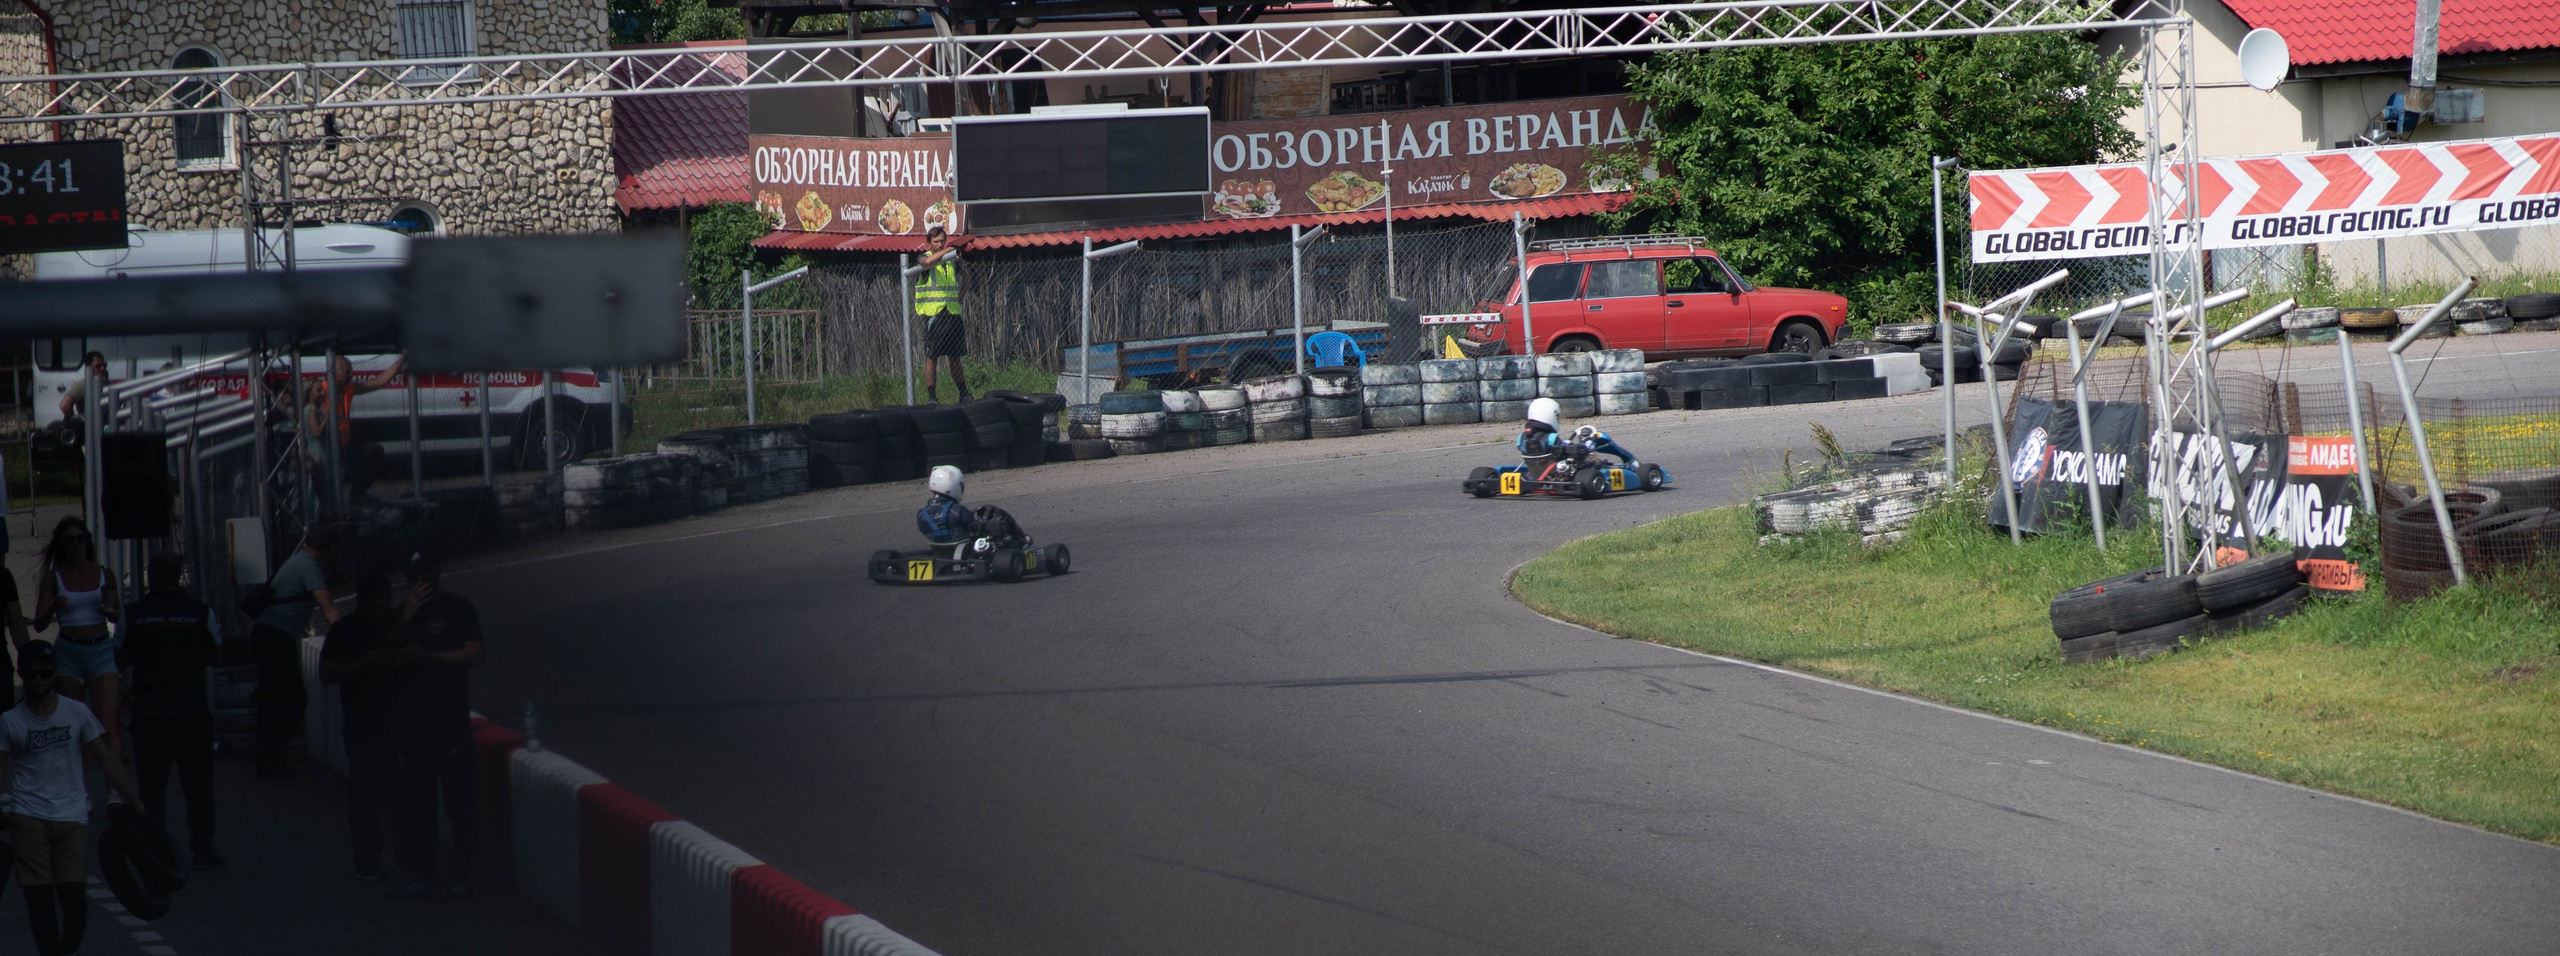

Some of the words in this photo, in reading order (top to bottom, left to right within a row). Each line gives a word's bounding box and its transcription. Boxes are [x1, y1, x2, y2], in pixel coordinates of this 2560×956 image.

[1213, 120, 1453, 173] ОБЗОРНАЯ
[1465, 104, 1665, 155] ВЕРАНДА
[755, 146, 861, 188] ОБЗОРНАЯ
[2052, 450, 2126, 486] YOKOAMA
[1504, 475, 1516, 492] 14
[1612, 470, 1623, 488] 14
[909, 561, 929, 580] 17
[31, 728, 68, 748] Riders
